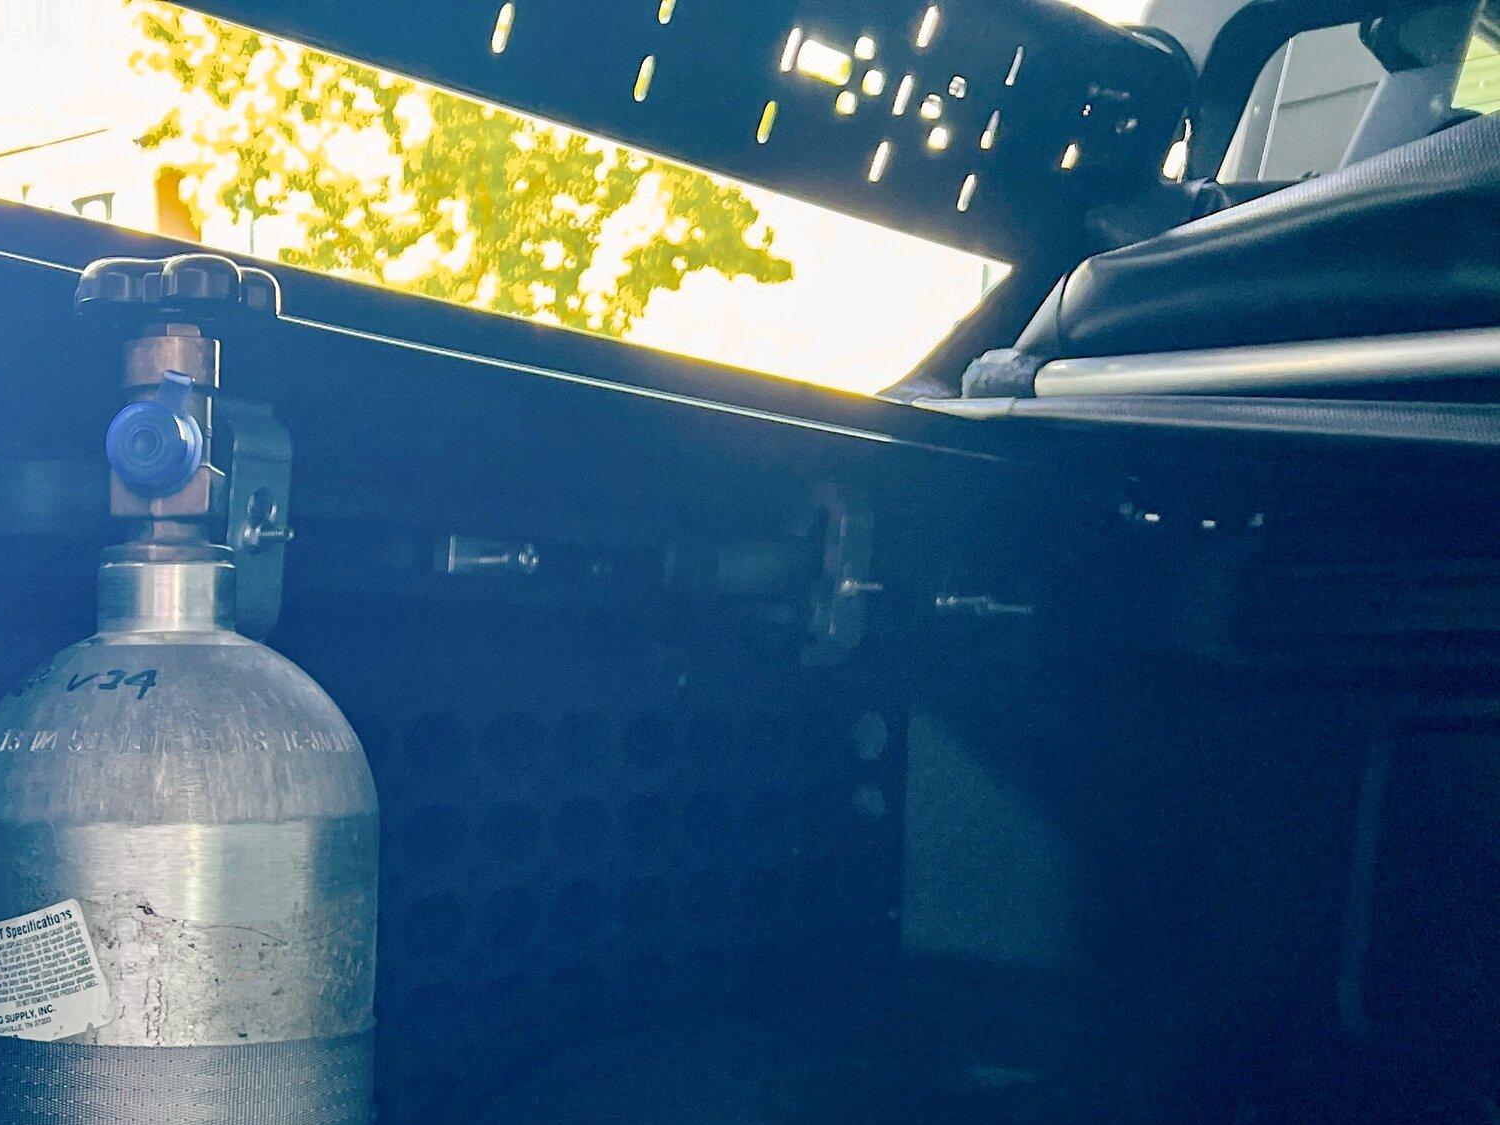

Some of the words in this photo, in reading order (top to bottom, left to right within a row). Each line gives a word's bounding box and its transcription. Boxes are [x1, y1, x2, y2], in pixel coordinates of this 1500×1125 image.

[5, 909, 73, 939] Specifications
[5, 1009, 37, 1024] SUPPLY,
[38, 1004, 57, 1016] INC.
